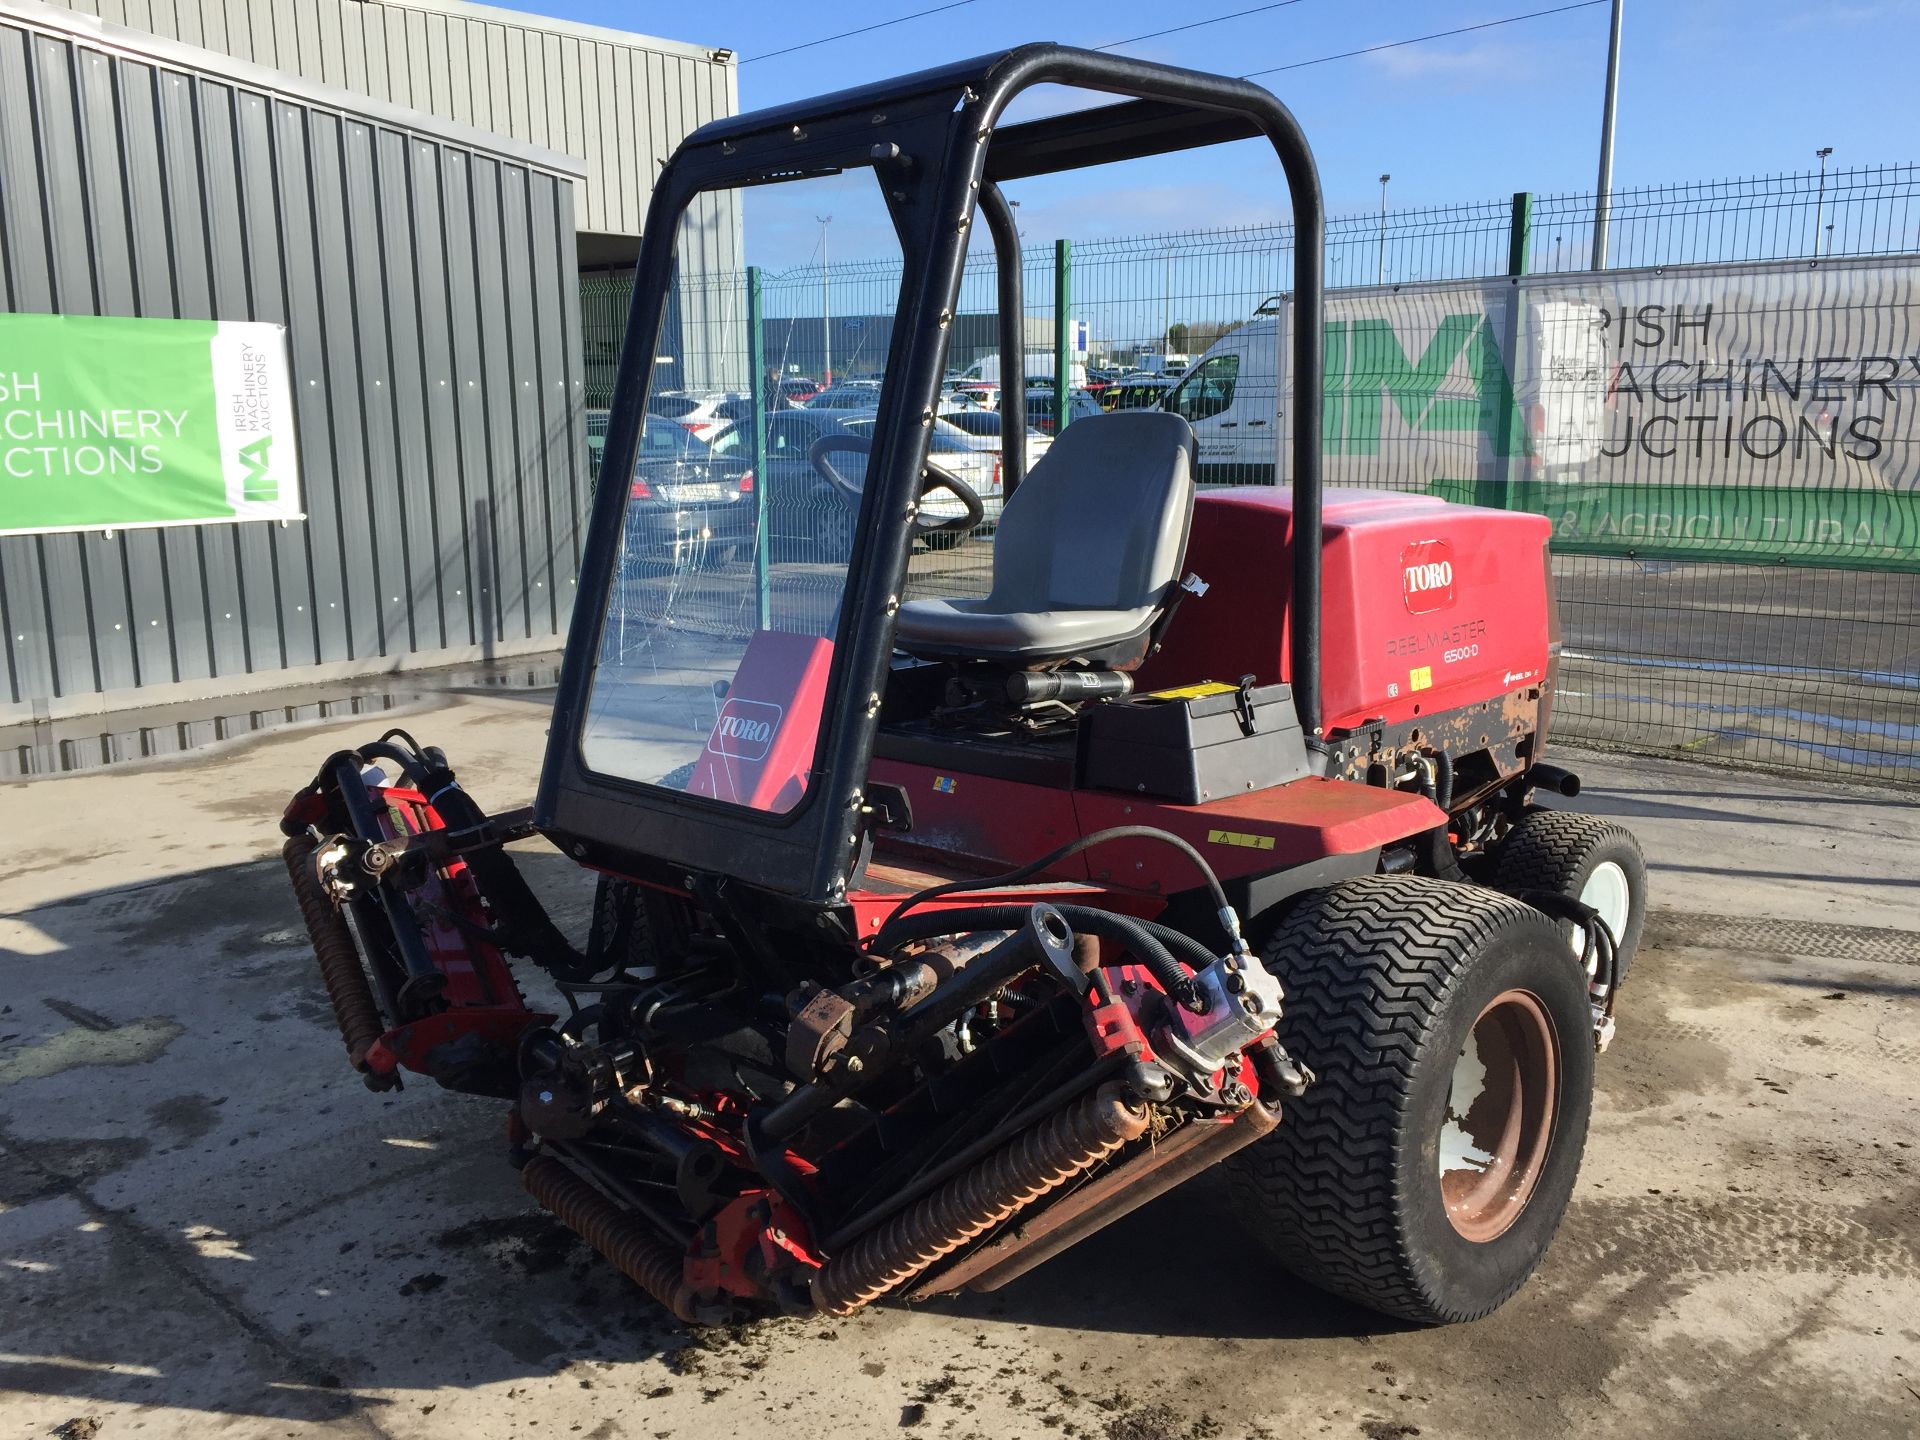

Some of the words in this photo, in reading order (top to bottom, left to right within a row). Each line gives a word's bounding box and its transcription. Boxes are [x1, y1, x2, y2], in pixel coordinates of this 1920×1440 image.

[241, 343, 260, 432] MACHINERY
[255, 354, 272, 432] AUCTIONS
[0, 409, 188, 440] CHINERY
[232, 394, 247, 432] IRISH
[1558, 510, 1580, 537] &
[1406, 560, 1453, 593] TORO
[1386, 619, 1487, 656] REELMASTER
